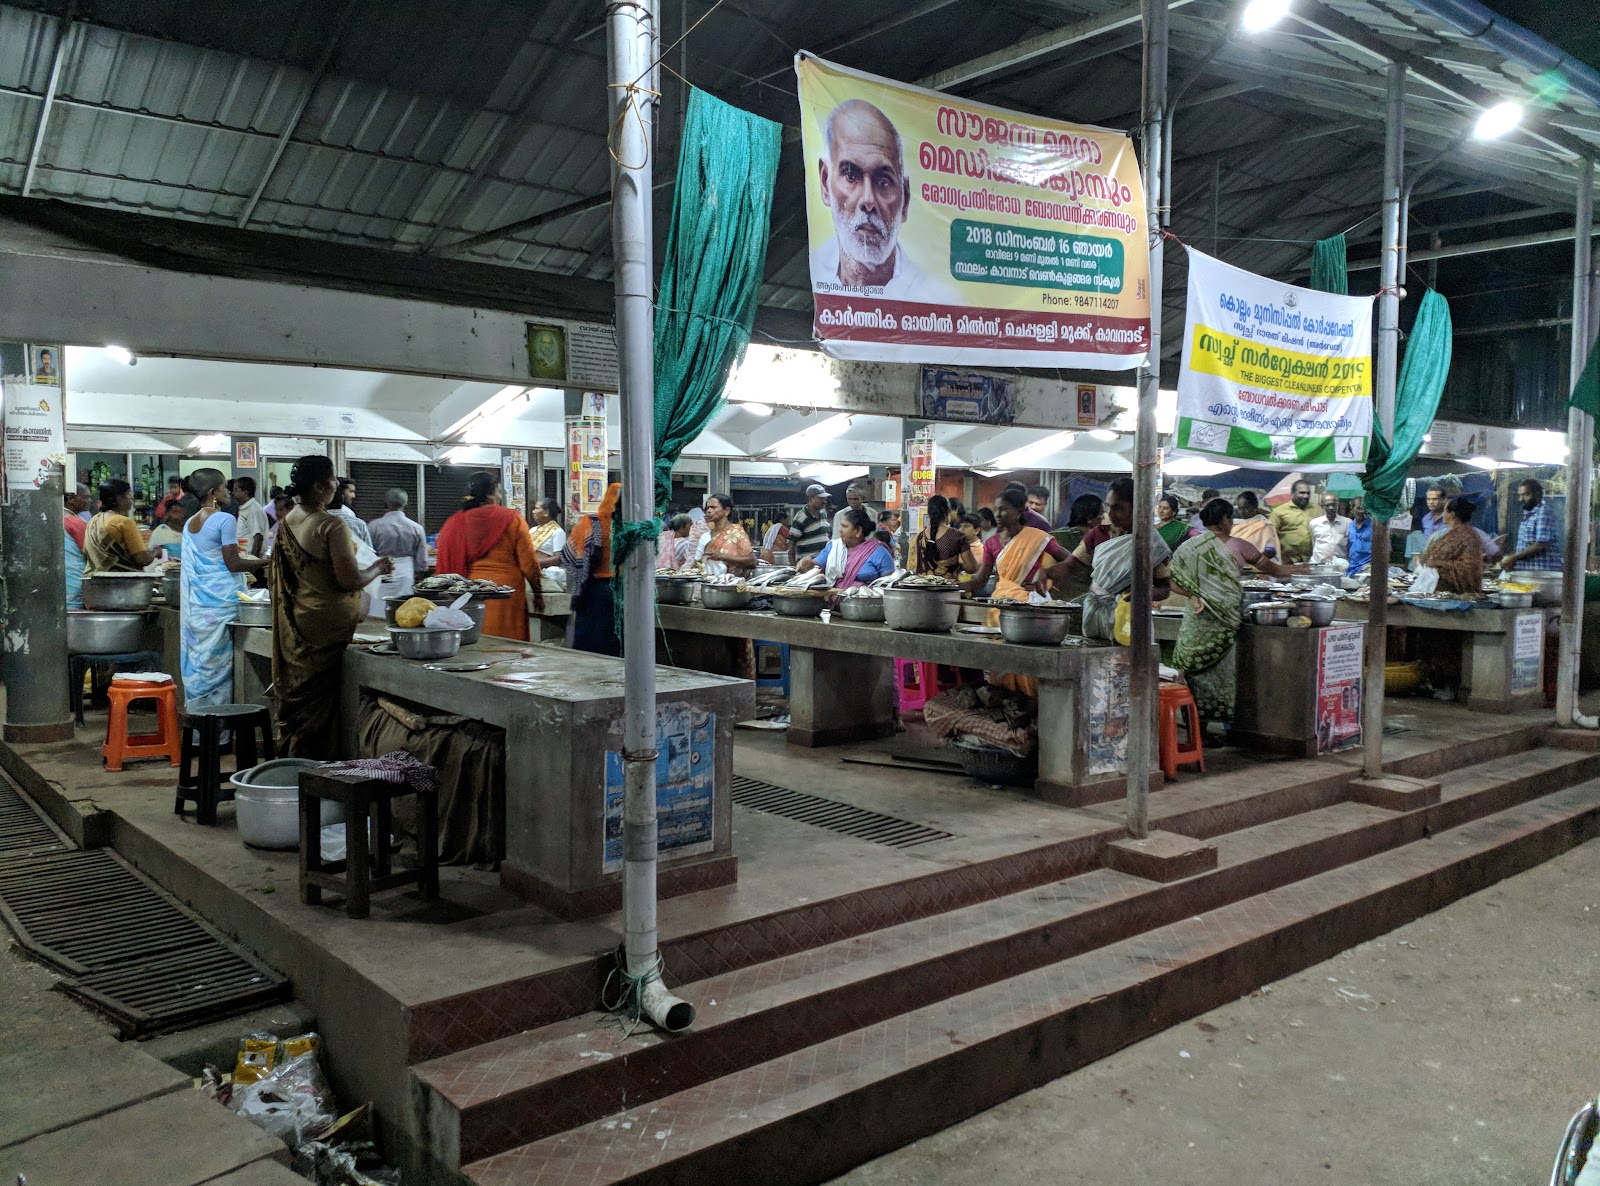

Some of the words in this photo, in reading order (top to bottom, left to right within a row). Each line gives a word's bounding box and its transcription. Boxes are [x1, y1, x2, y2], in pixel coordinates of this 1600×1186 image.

[966, 226, 993, 246] 2018
[994, 230, 1056, 253] ഡിസംബർ
[1057, 238, 1070, 254] 16
[1071, 241, 1114, 259] ഞായർ
[1014, 251, 1019, 261] 9
[1060, 257, 1065, 266] 1
[989, 265, 1029, 280] കാവനാട്
[1042, 293, 1073, 307] Phone:
[1074, 295, 1119, 310] 9847114207
[1219, 292, 1252, 324] കൊല്ലം
[819, 305, 898, 331] കാർത്തിക
[901, 311, 954, 334] ഓയിൽ
[1094, 325, 1146, 343] കാവനാട്
[1240, 369, 1254, 383] THE
[1254, 372, 1284, 388] BIGGEST
[1284, 380, 1323, 395] CLEANLINESS
